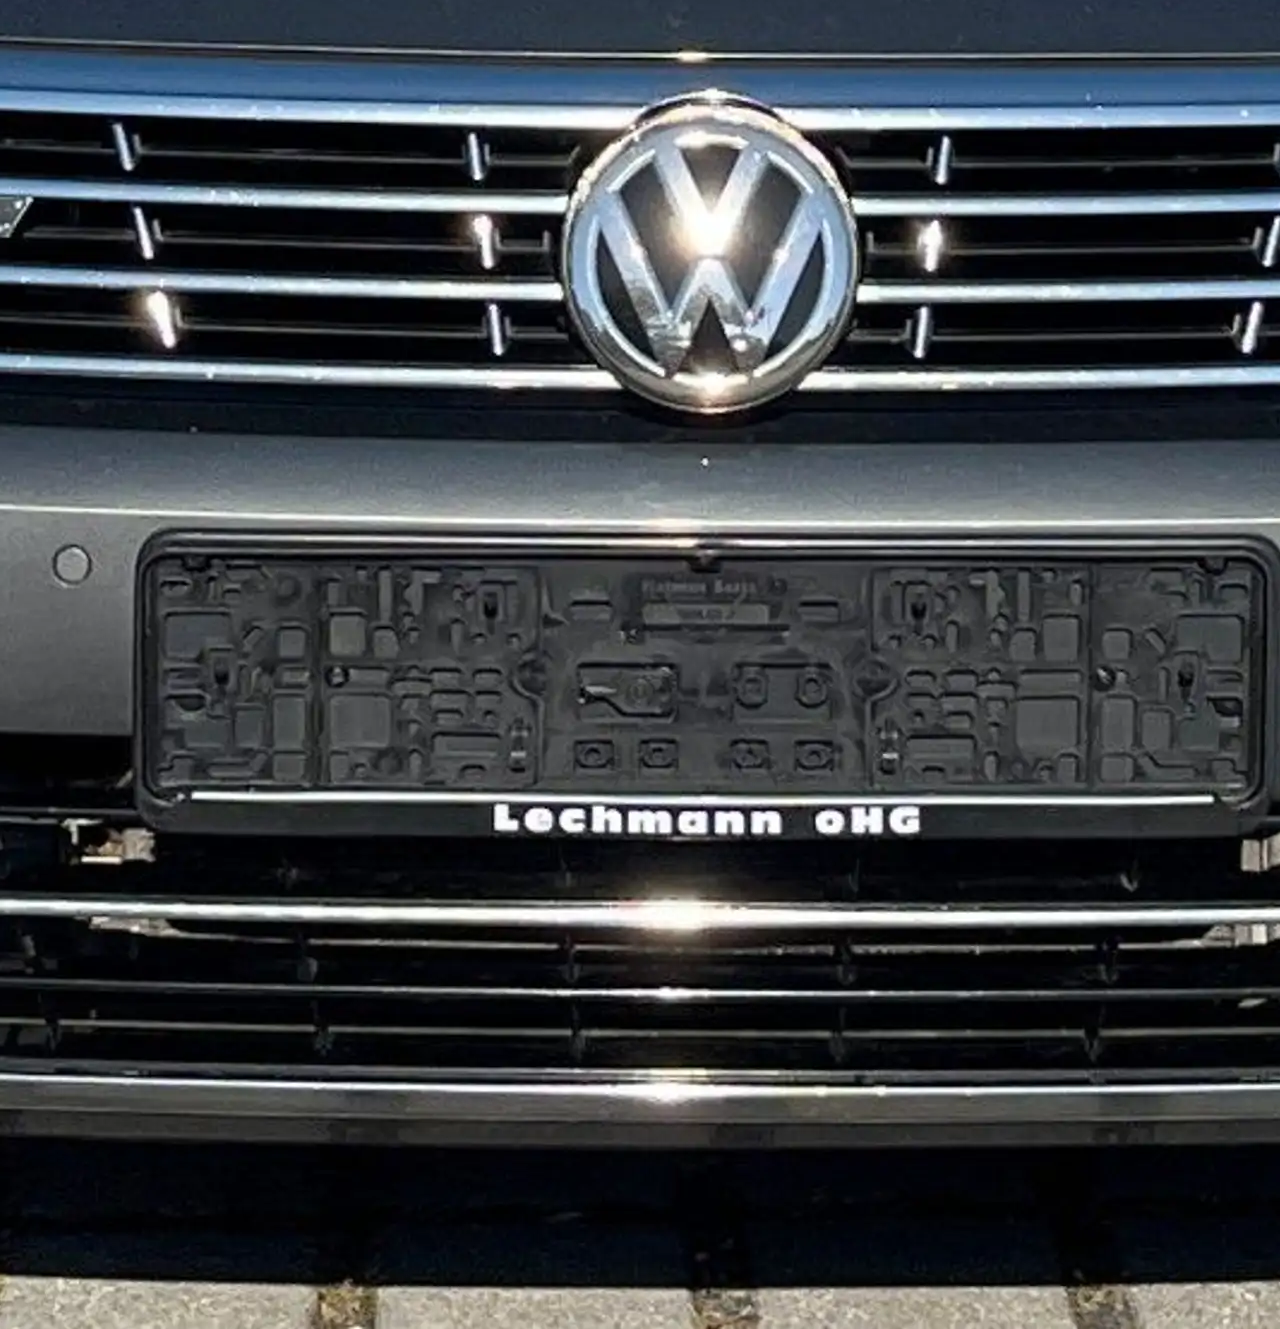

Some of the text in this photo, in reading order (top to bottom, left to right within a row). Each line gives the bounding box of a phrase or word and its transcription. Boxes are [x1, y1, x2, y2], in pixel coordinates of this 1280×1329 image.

[586, 126, 834, 380] VW
[492, 803, 922, 836] Lechmann oHG
